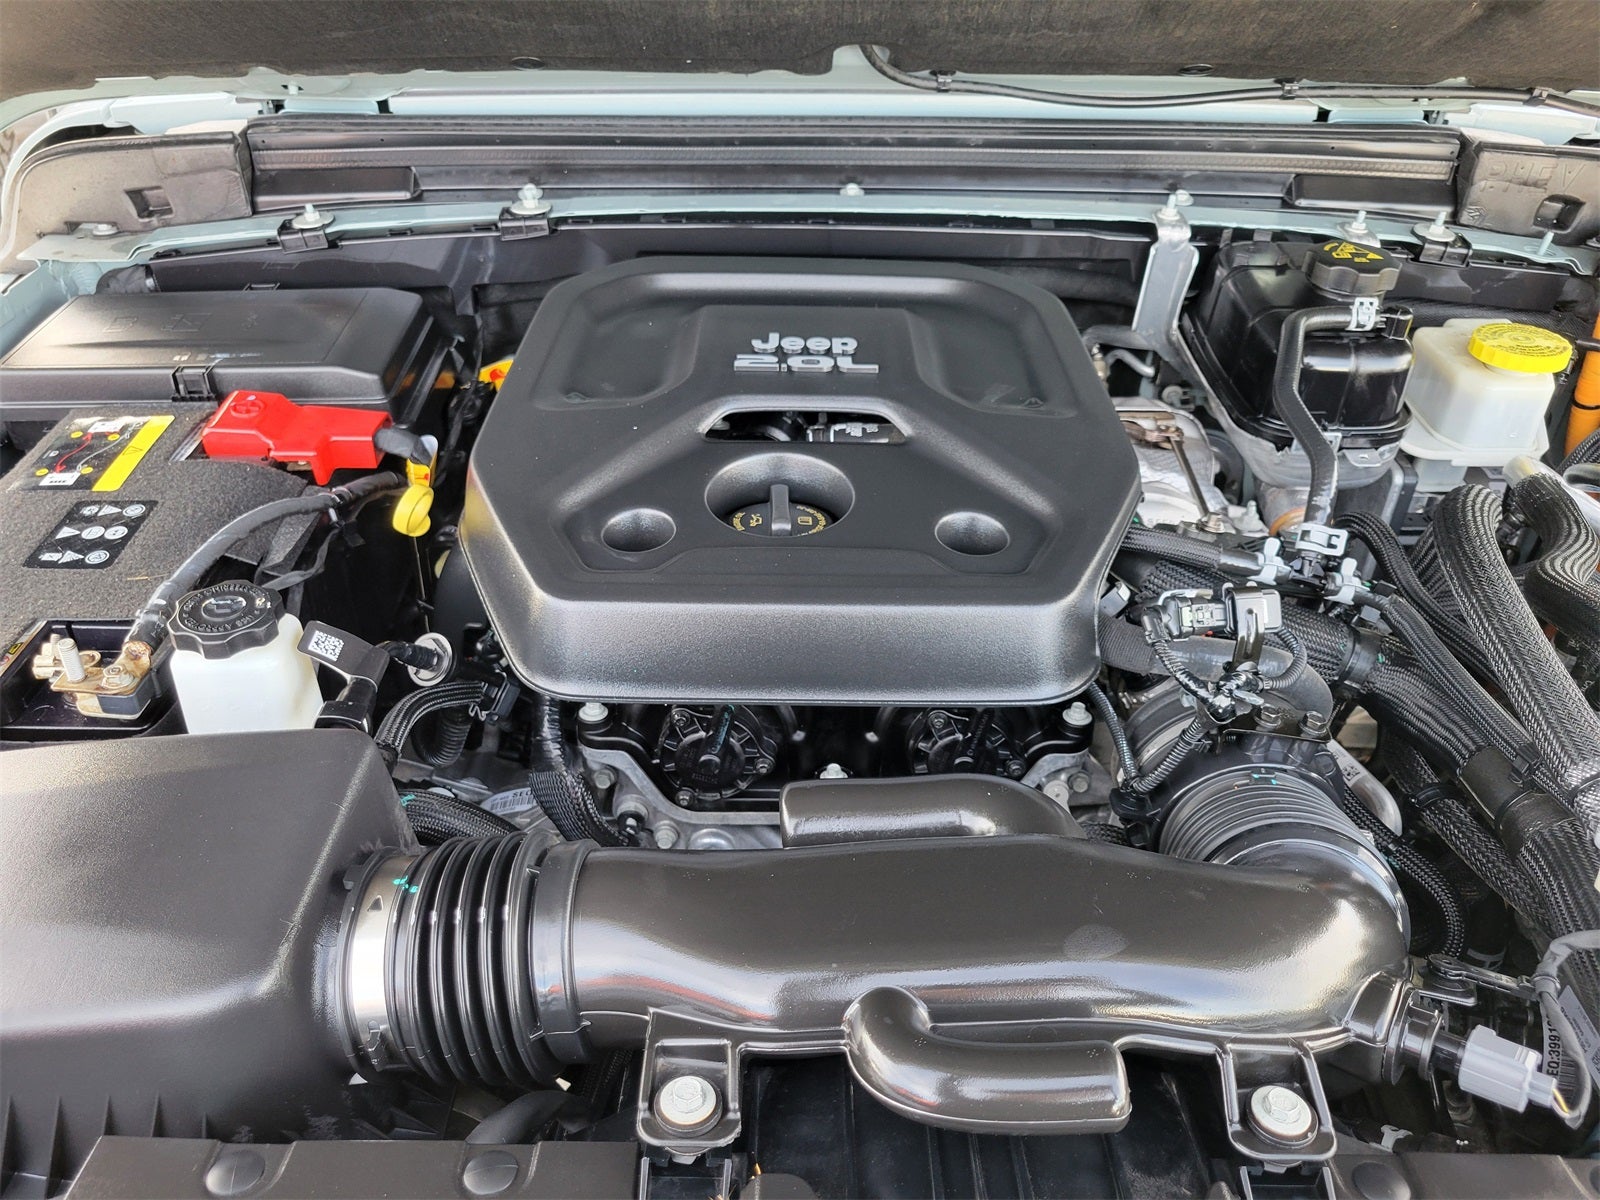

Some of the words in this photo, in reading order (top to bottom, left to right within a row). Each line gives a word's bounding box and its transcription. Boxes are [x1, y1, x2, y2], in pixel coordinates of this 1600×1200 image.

[1479, 160, 1586, 193] PHEV
[751, 332, 858, 356] Jeep
[733, 353, 880, 374] 2.0L
